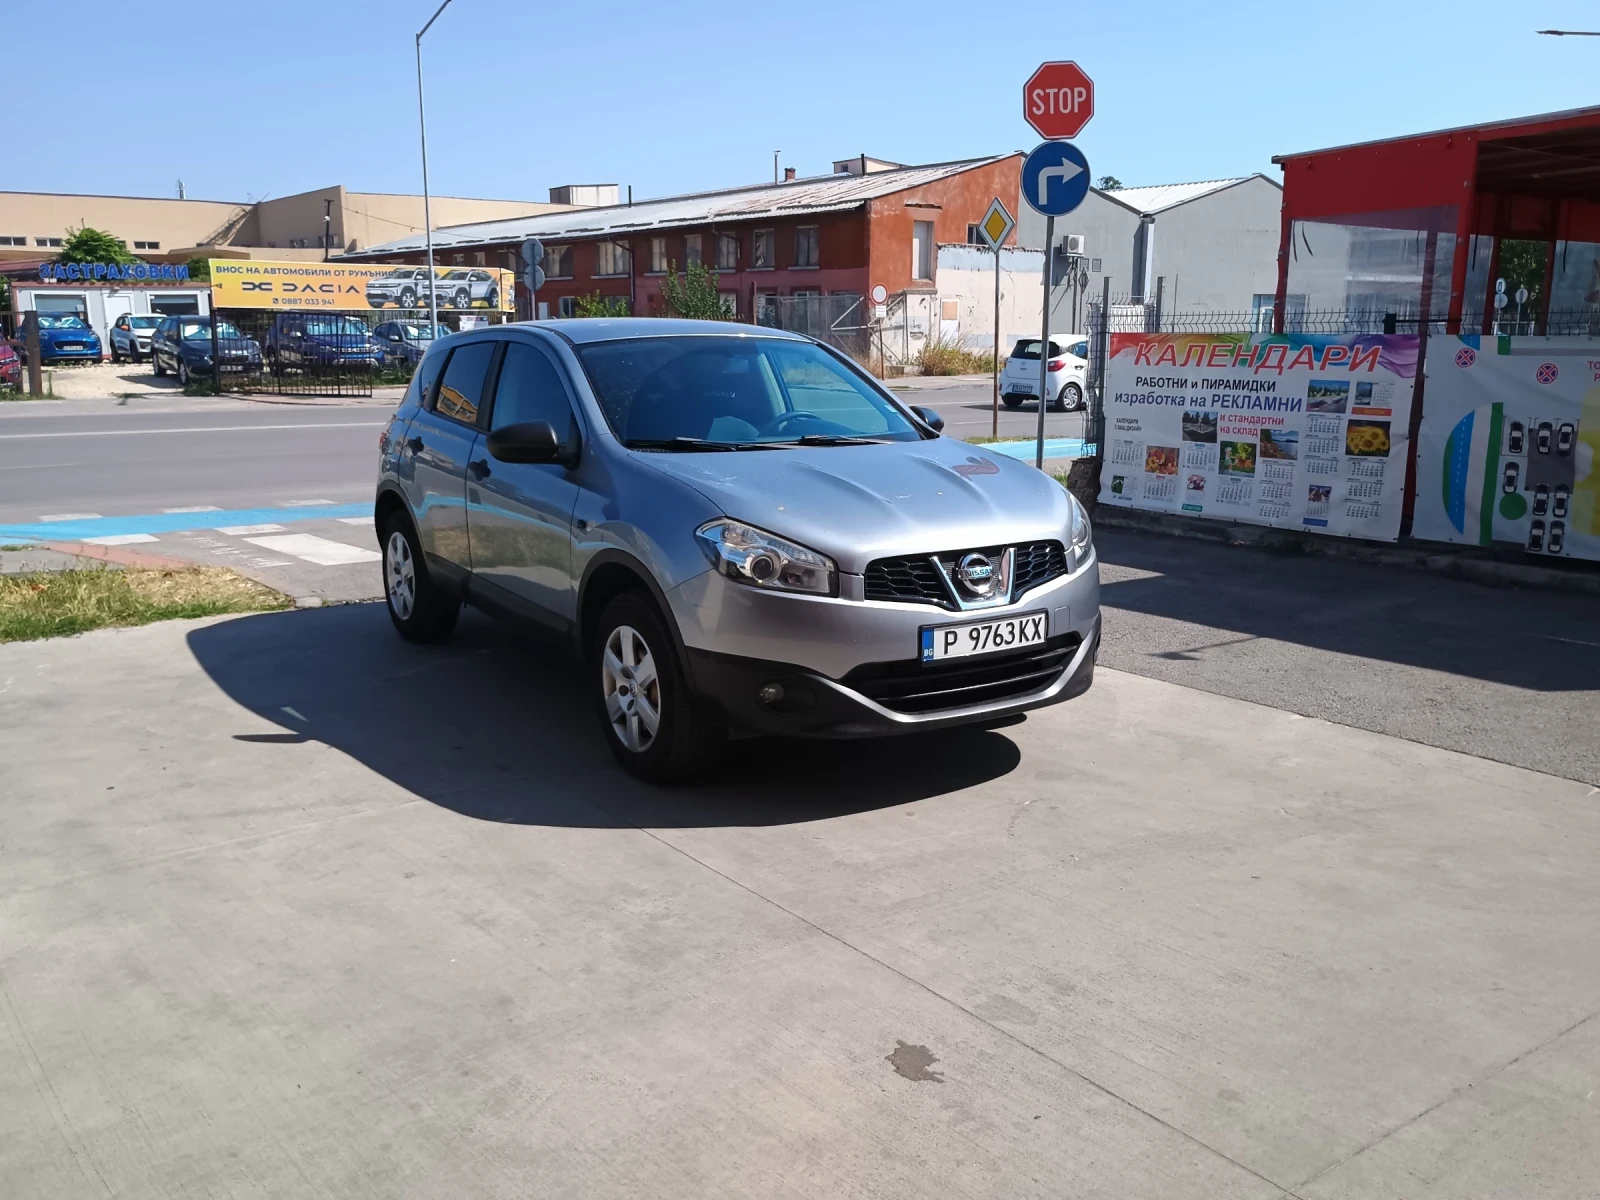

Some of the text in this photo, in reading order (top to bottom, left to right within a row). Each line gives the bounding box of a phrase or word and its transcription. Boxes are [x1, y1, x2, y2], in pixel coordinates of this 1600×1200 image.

[1032, 86, 1087, 115] STOP
[38, 263, 190, 280] ЗАСТРАХОВКИ
[215, 265, 394, 277] ВНОС НА АВТОМОБИЛИ ОТ РУМЪНИЯ
[282, 282, 360, 294] DACIA
[281, 297, 303, 306] 0887
[305, 298, 320, 306] 033
[1133, 342, 1383, 376] КАЛЕНДАРИ
[1135, 376, 1276, 394] РАБОТНИ и ПИРАМИДКИ
[1114, 391, 1303, 413] изработка на РЕКЛАМНИ
[1219, 413, 1285, 426] и стандартни
[1219, 426, 1259, 438] на склад
[923, 648, 933, 656] BG
